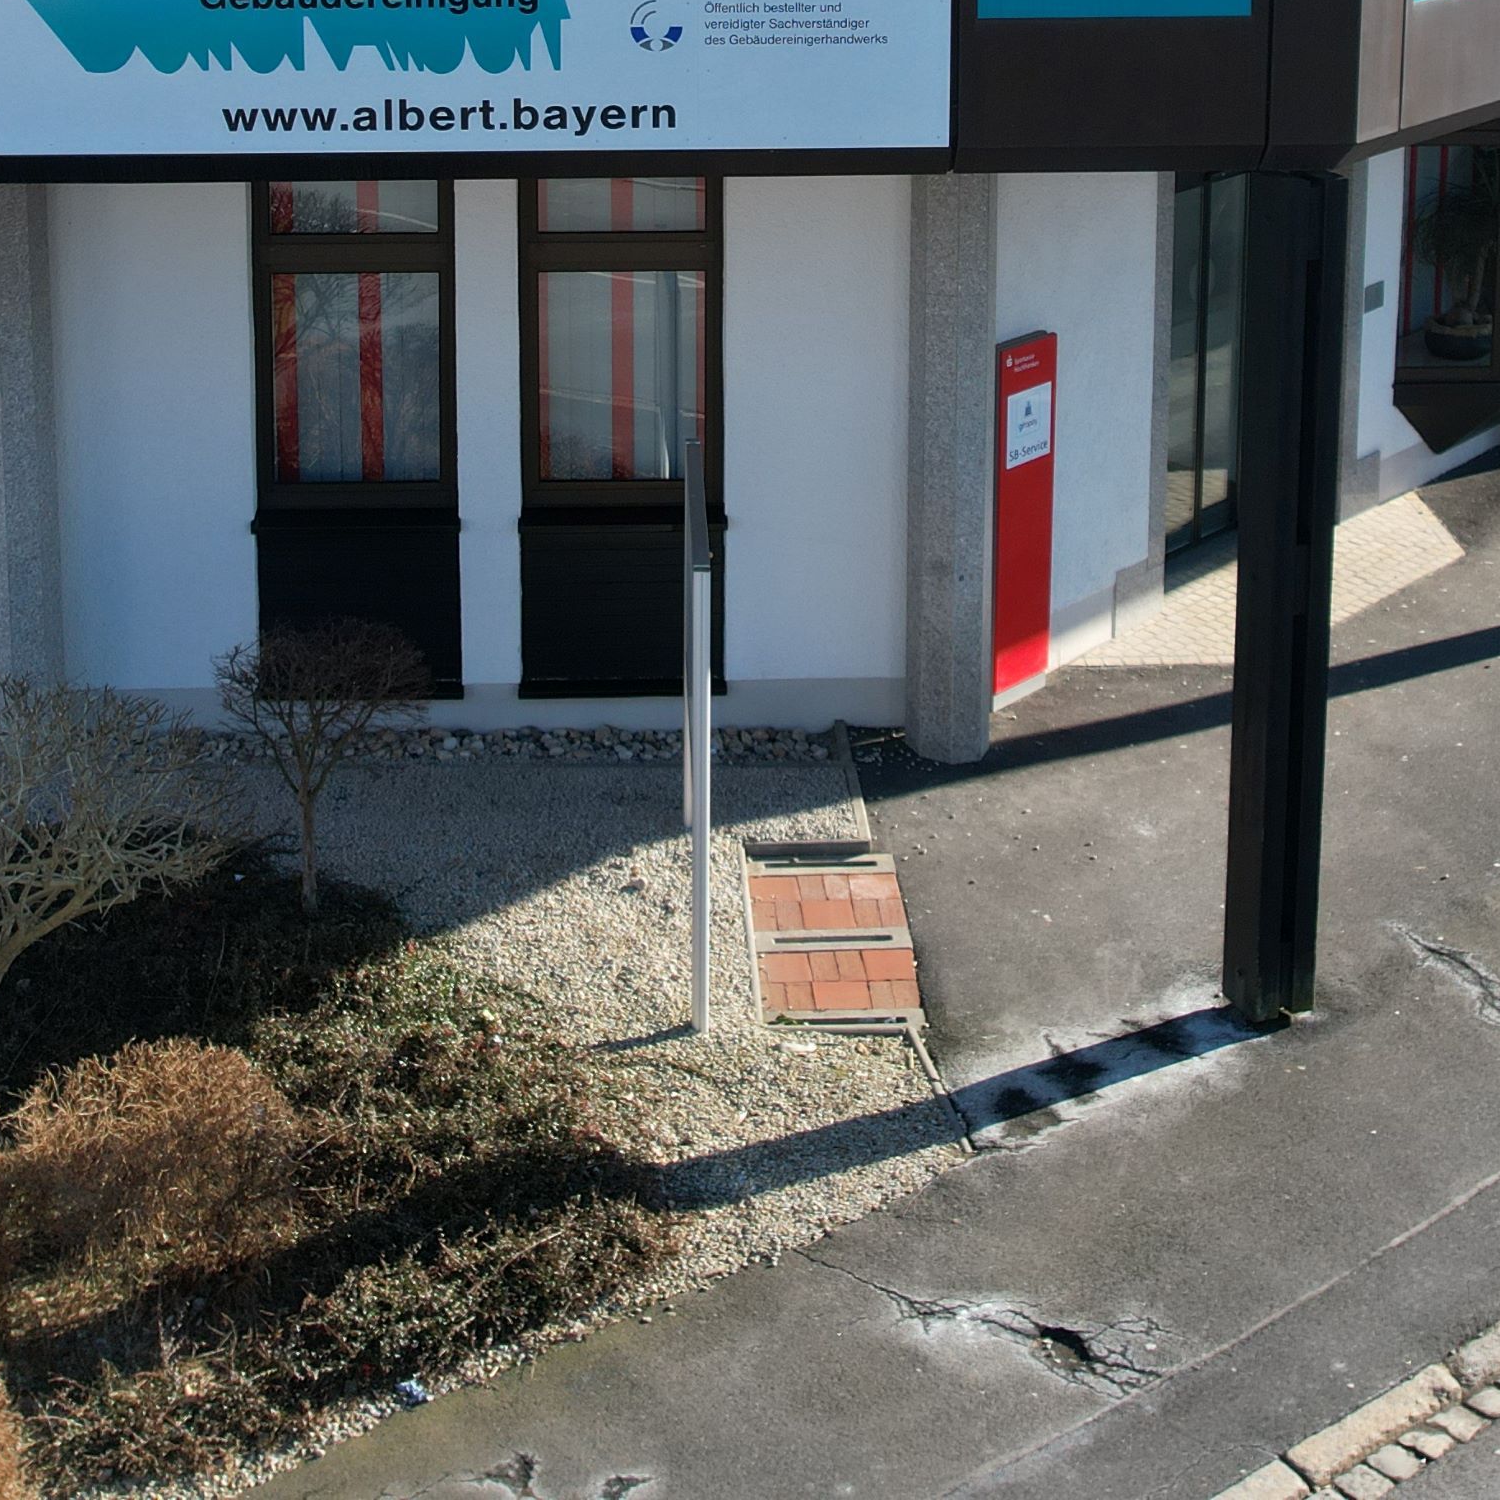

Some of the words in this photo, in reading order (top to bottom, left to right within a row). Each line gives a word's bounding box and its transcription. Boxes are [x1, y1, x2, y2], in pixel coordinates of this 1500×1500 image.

[704, 1, 760, 14] Öffentlich
[763, 2, 817, 14] bestellter
[819, 2, 842, 13] und
[704, 18, 766, 31] vereidigter
[768, 17, 870, 31] Sachverständiger
[704, 34, 726, 46] des
[728, 33, 889, 47] Gebäudereinigerhandwerks
[222, 97, 678, 138] www.albert.bayern
[1008, 440, 1049, 463] SB-Service
